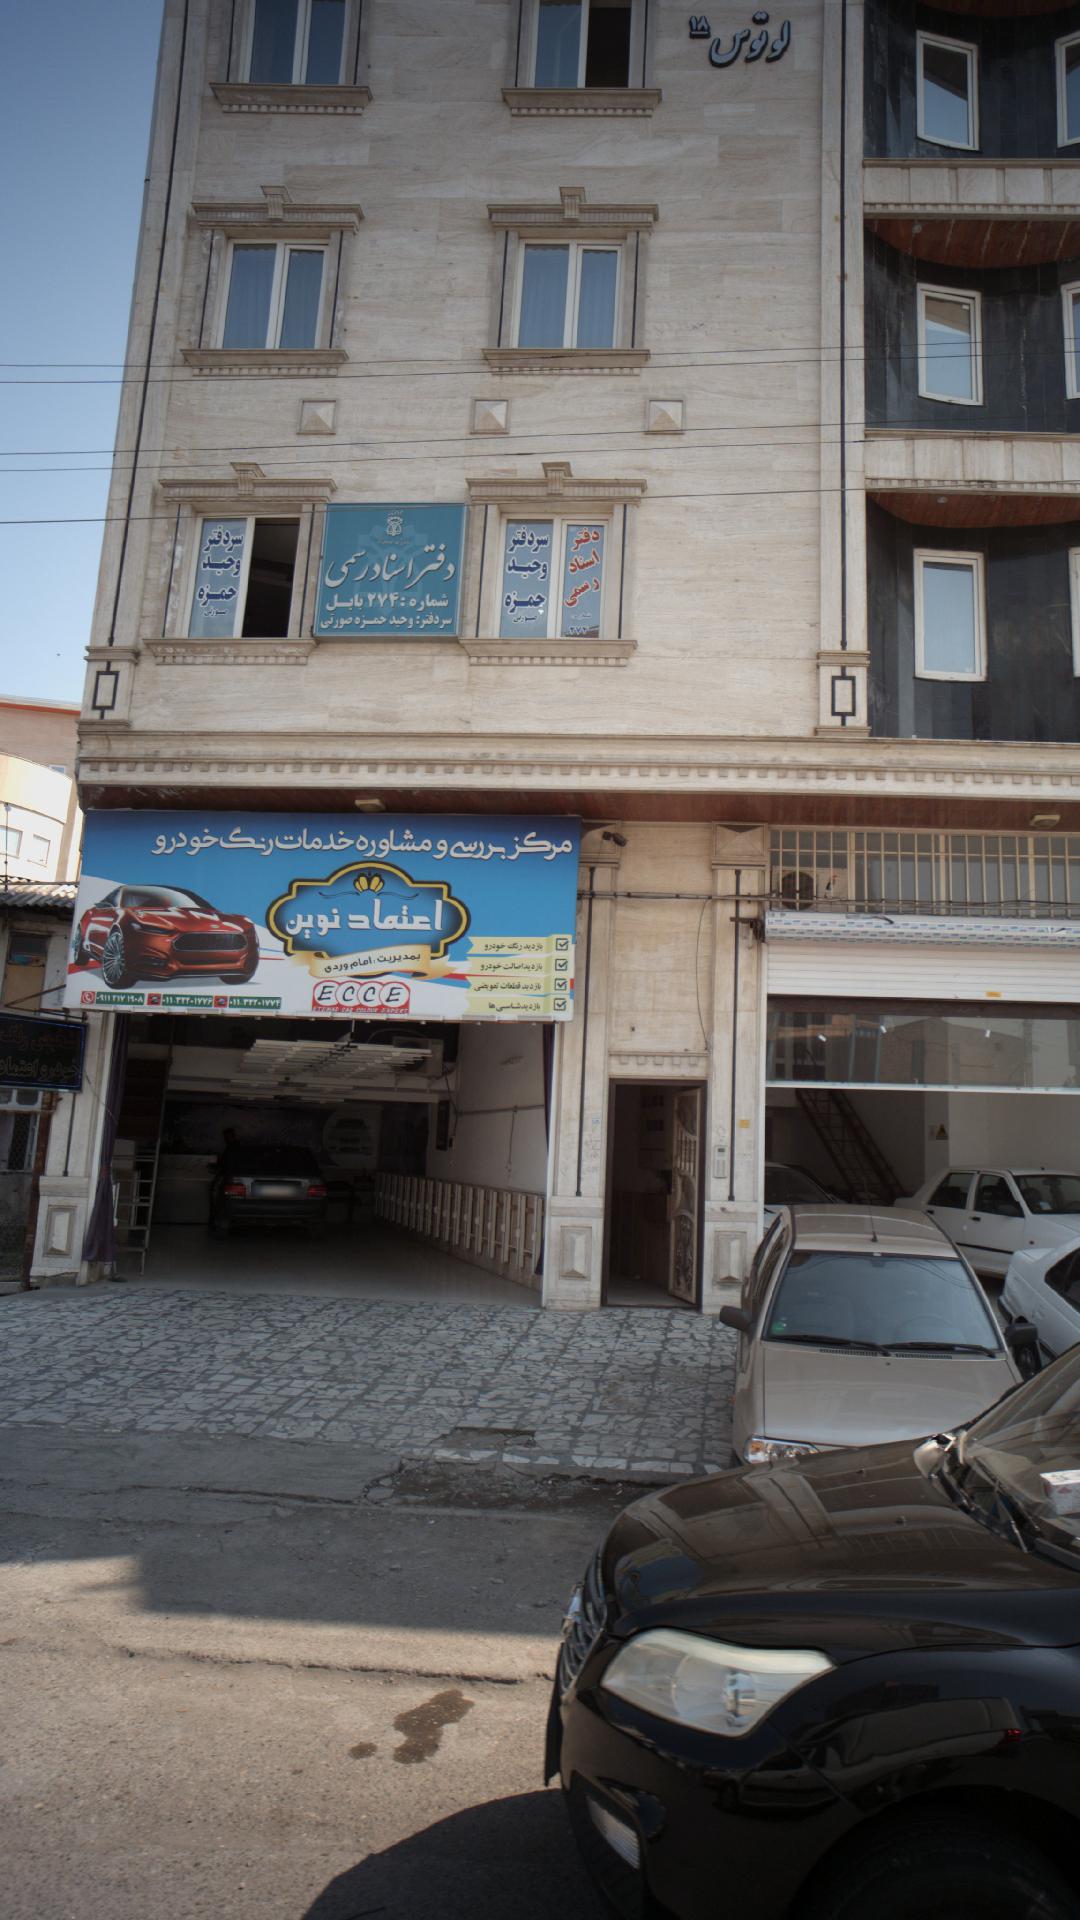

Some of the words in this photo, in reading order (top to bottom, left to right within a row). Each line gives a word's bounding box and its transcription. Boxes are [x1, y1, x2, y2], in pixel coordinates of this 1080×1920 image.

[709, 10, 791, 68] لوتوس
[203, 525, 244, 552] سردفتر
[508, 525, 549, 553] سردفتر
[572, 527, 600, 551] دفتر
[202, 555, 241, 577] وحید
[324, 549, 369, 588] رسمی
[369, 553, 414, 581] اسناد
[403, 543, 456, 590] دفتر
[507, 558, 547, 580] وحید
[569, 549, 600, 573] اسناد
[197, 584, 237, 607] حمزه
[367, 592, 399, 608] ۲۷۴
[504, 591, 545, 614] حمزه
[320, 612, 353, 629] صورتی
[354, 614, 387, 628] حمزه
[389, 614, 414, 629] وحید
[151, 828, 220, 856] خودرو
[220, 826, 274, 856] رنگ
[275, 827, 355, 851] خدمات
[356, 829, 433, 858] مشاوره
[432, 838, 448, 859] و
[449, 840, 506, 860] بررسی
[507, 831, 573, 860] مرکز
[285, 908, 341, 939] نوین
[348, 898, 443, 931] اعتماد
[350, 955, 372, 969] امام
